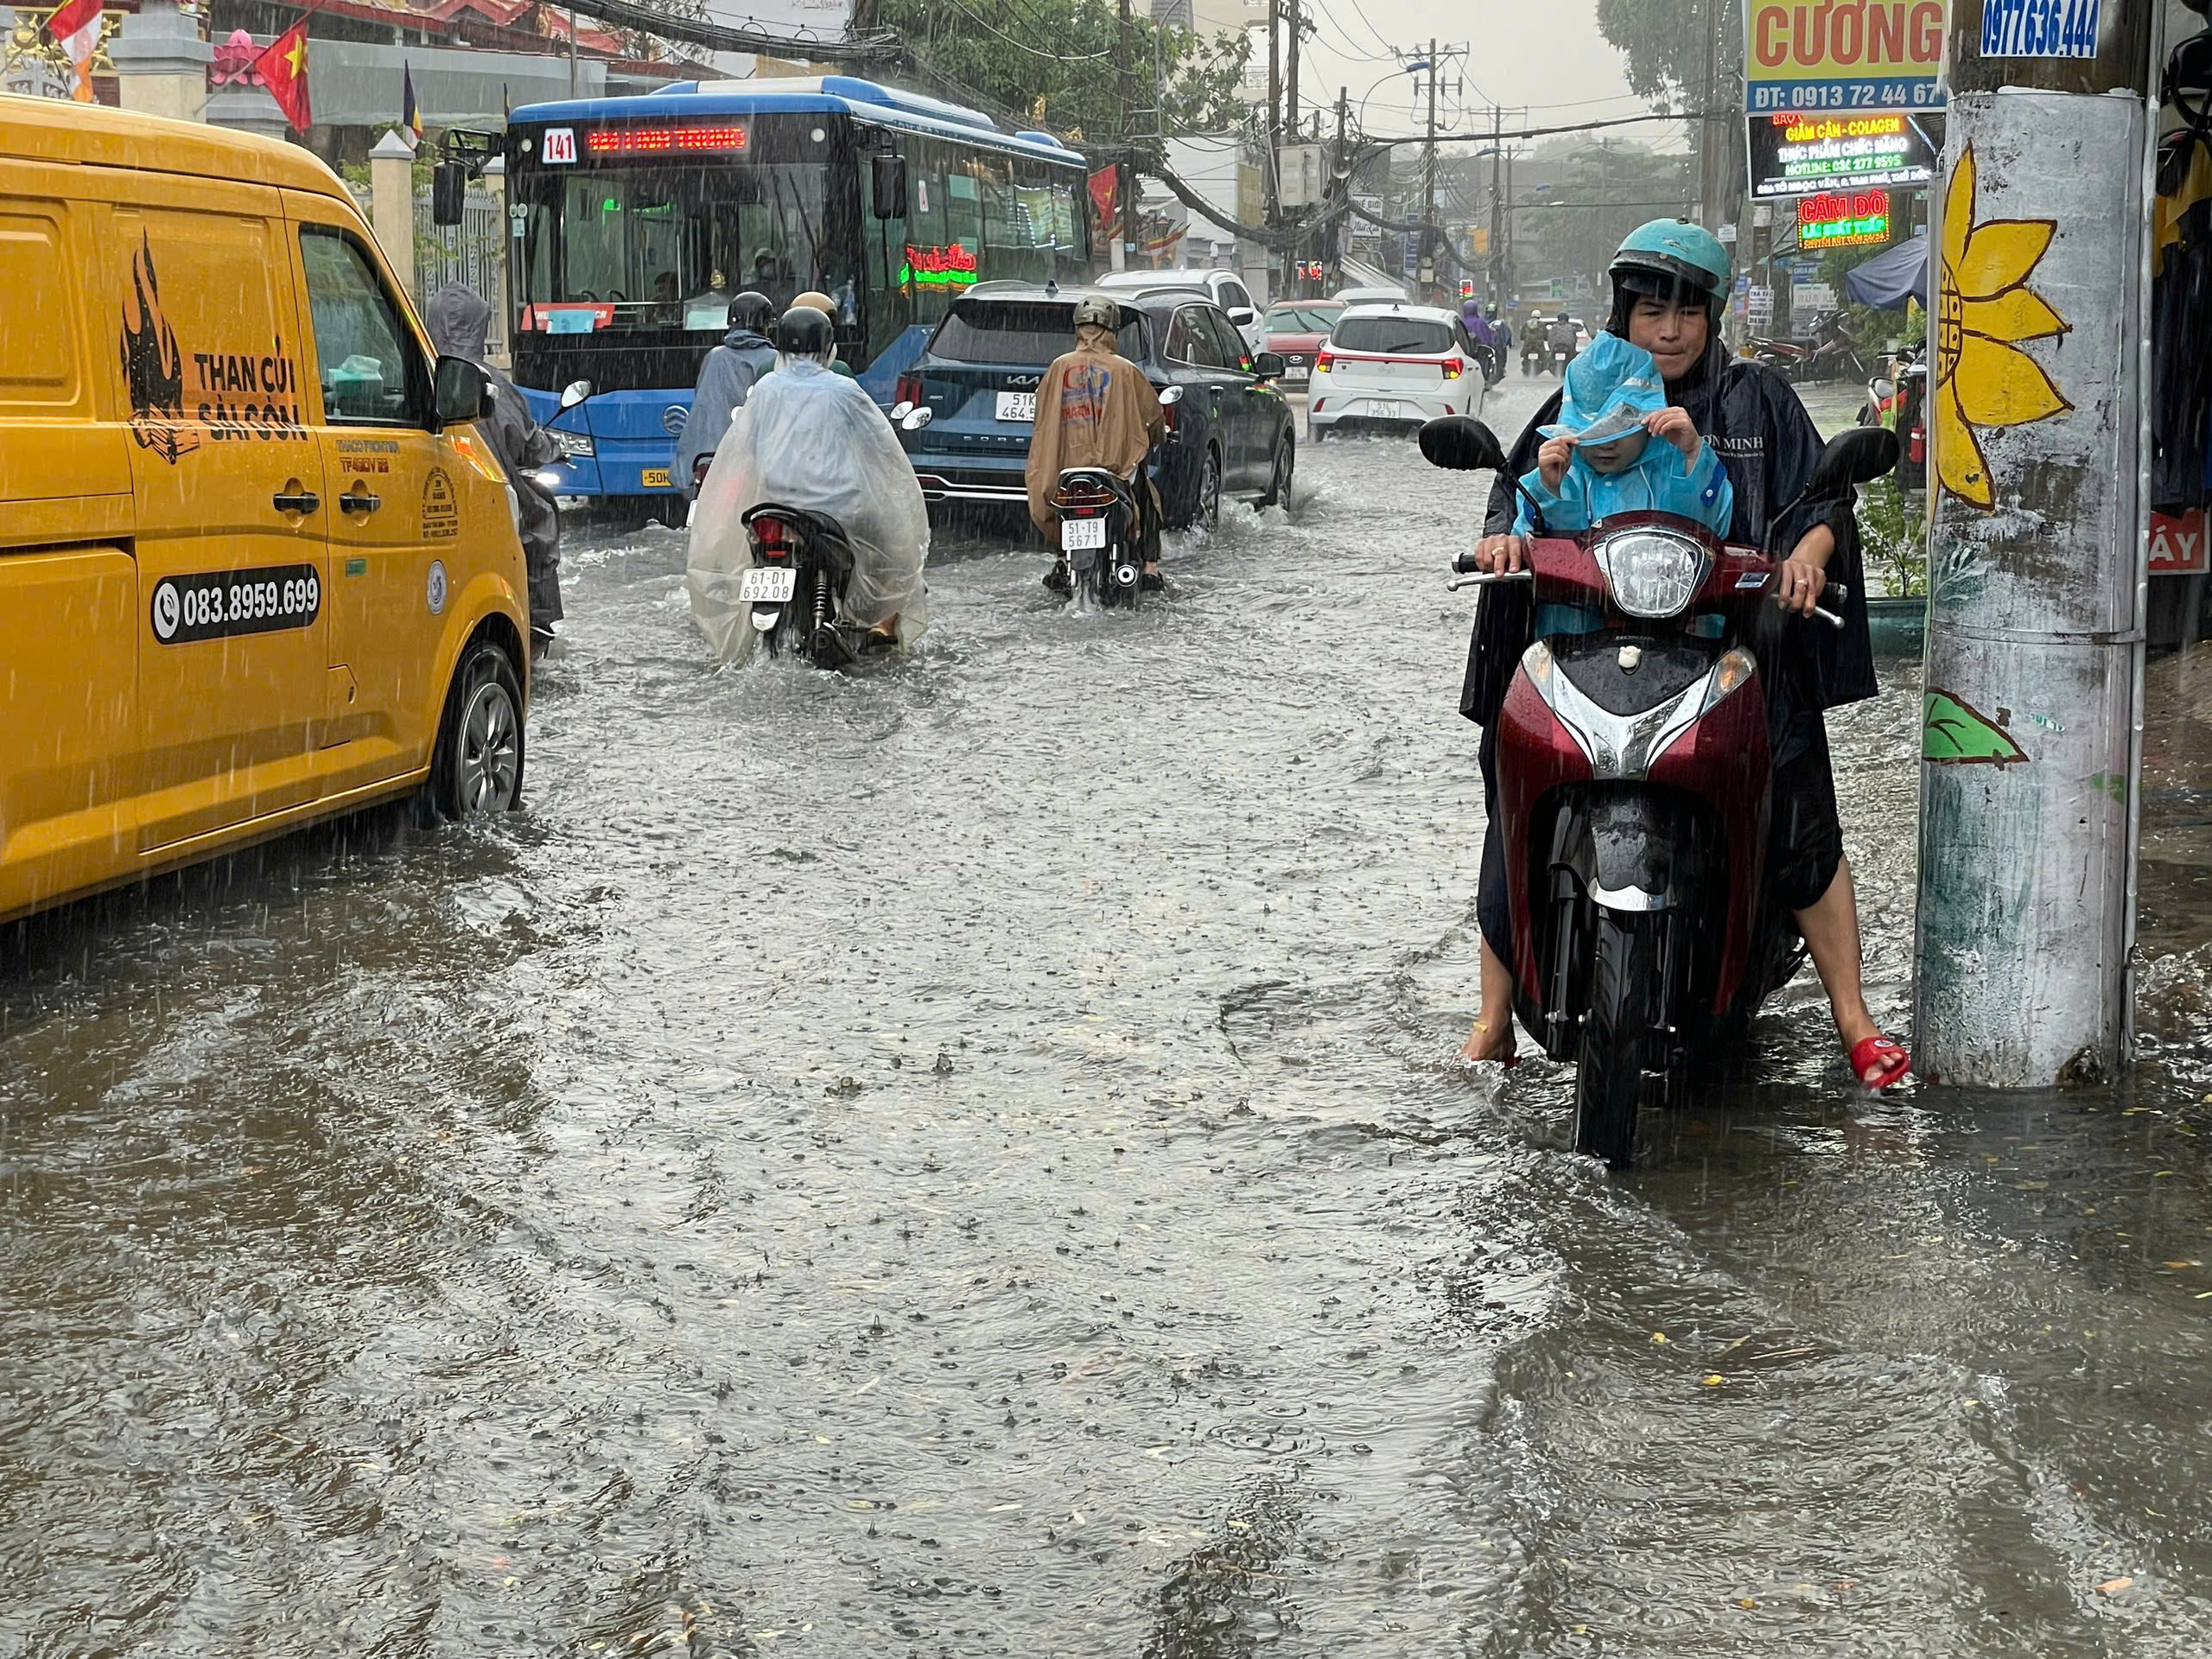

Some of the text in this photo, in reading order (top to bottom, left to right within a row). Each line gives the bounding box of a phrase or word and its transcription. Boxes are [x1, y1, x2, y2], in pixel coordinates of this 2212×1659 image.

[1983, 0, 2098, 56] 0977.636.444
[1755, 83, 1937, 108] ĐT: 0913 72 44 67
[1816, 120, 1841, 138] CÂN
[1848, 118, 1900, 137] COLAGEN
[547, 135, 572, 160] 141
[1785, 162, 1831, 176] HOTLINE:
[194, 354, 257, 392] THAN
[1013, 394, 1036, 406] 51K
[198, 394, 308, 442] SÀI GÒN
[1724, 436, 1763, 449] MINH
[1068, 521, 1098, 535] 51-T9
[1068, 535, 1097, 548] 5671
[2149, 524, 2199, 561] ÁY
[750, 571, 786, 585] 61-D1
[183, 577, 319, 627] 083.8959.699
[743, 586, 790, 599] 692.08
